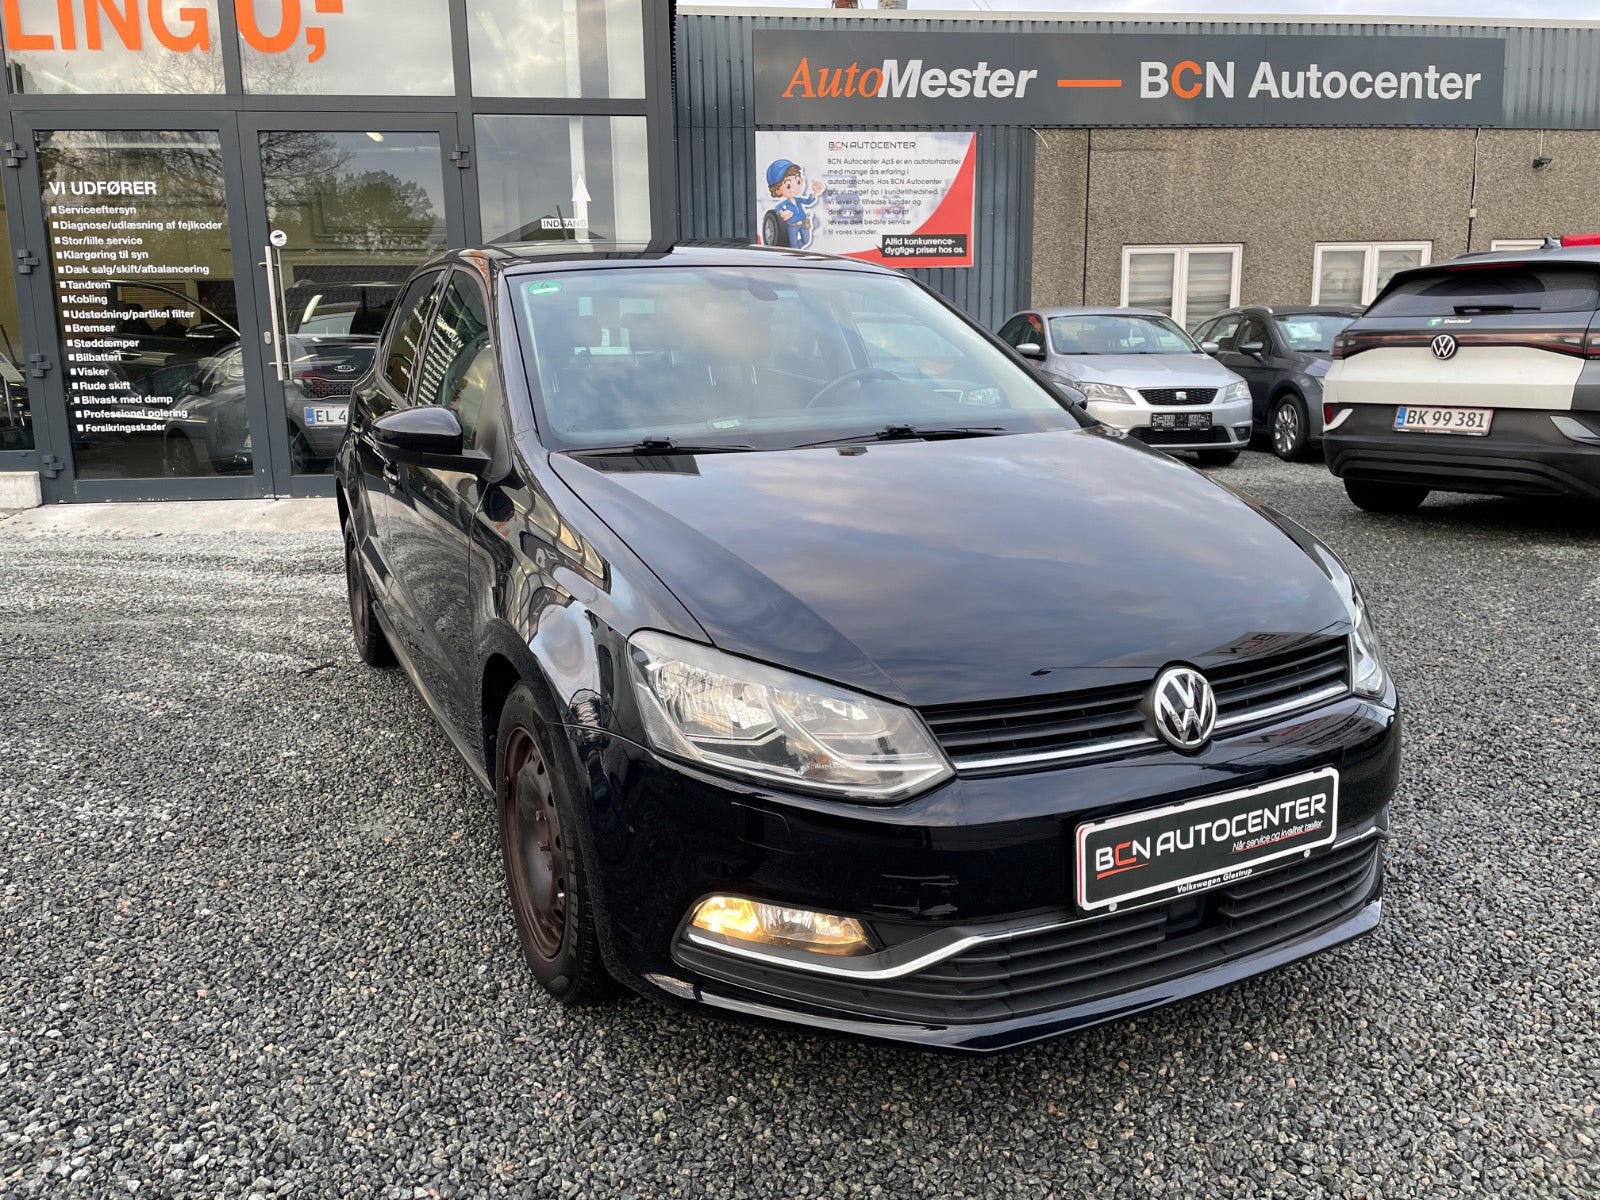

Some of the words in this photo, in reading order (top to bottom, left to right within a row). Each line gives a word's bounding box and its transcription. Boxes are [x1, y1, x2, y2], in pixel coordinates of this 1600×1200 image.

[0, 0, 211, 52] LING
[782, 57, 1038, 98] AutoMester
[1140, 60, 1235, 99] BCN
[1248, 61, 1482, 100] Autocenter
[828, 141, 848, 149] BCN
[850, 141, 917, 149] AUTOCENTER
[881, 158, 894, 166] ApS
[844, 169, 868, 177] mange
[880, 168, 906, 177] erfaring
[48, 181, 66, 195] VI
[71, 181, 157, 195] UDFØRER
[58, 205, 136, 215] Serviceeftersyn
[60, 221, 163, 231] Diagnose/udlæsning
[166, 221, 176, 230] af
[178, 221, 222, 231] fejlkoder
[543, 219, 587, 228] INDGANG
[62, 236, 104, 246] Stor/lille
[106, 236, 143, 245] service
[885, 237, 903, 245] Altid
[904, 237, 955, 245] konkurrence-
[885, 246, 915, 255] dygtige
[916, 246, 937, 255] priser
[938, 246, 952, 254] hos
[63, 251, 117, 261] Klargøring
[118, 251, 129, 260] til
[131, 252, 149, 261] syn
[65, 265, 89, 274] Dæk
[91, 265, 210, 275] salg/skift/afbalancering
[67, 281, 111, 290] Tandrem
[69, 295, 108, 305] Kobling
[71, 310, 169, 320] Udstødning/partikel
[171, 310, 195, 319] filter
[72, 324, 116, 333] Bremser
[74, 339, 140, 349] Støddæmper
[76, 353, 122, 362] Bilbatteri
[77, 368, 109, 376] Visker
[80, 382, 106, 390] Rude
[108, 382, 131, 390] skift
[82, 396, 118, 404] Bilvask
[120, 396, 142, 404] med
[144, 396, 173, 406] damp
[84, 410, 145, 419] Professionel
[147, 410, 188, 420] polering
[316, 410, 334, 423] EL
[338, 410, 347, 422] 4
[1407, 410, 1429, 425] BK
[1432, 410, 1452, 426] 99
[1455, 412, 1485, 428] 381
[86, 424, 166, 433] Forsikringsskader
[1095, 836, 1150, 872] BCN
[1156, 793, 1326, 857] AUTOCENTER
[1232, 840, 1246, 851] Når
[1246, 835, 1271, 849] service
[1271, 831, 1281, 842] og
[1281, 825, 1304, 837] kvalitet
[1304, 820, 1323, 832] tæller
[1177, 877, 1221, 893] Volkswagen
[1222, 868, 1253, 881] Glostrup
